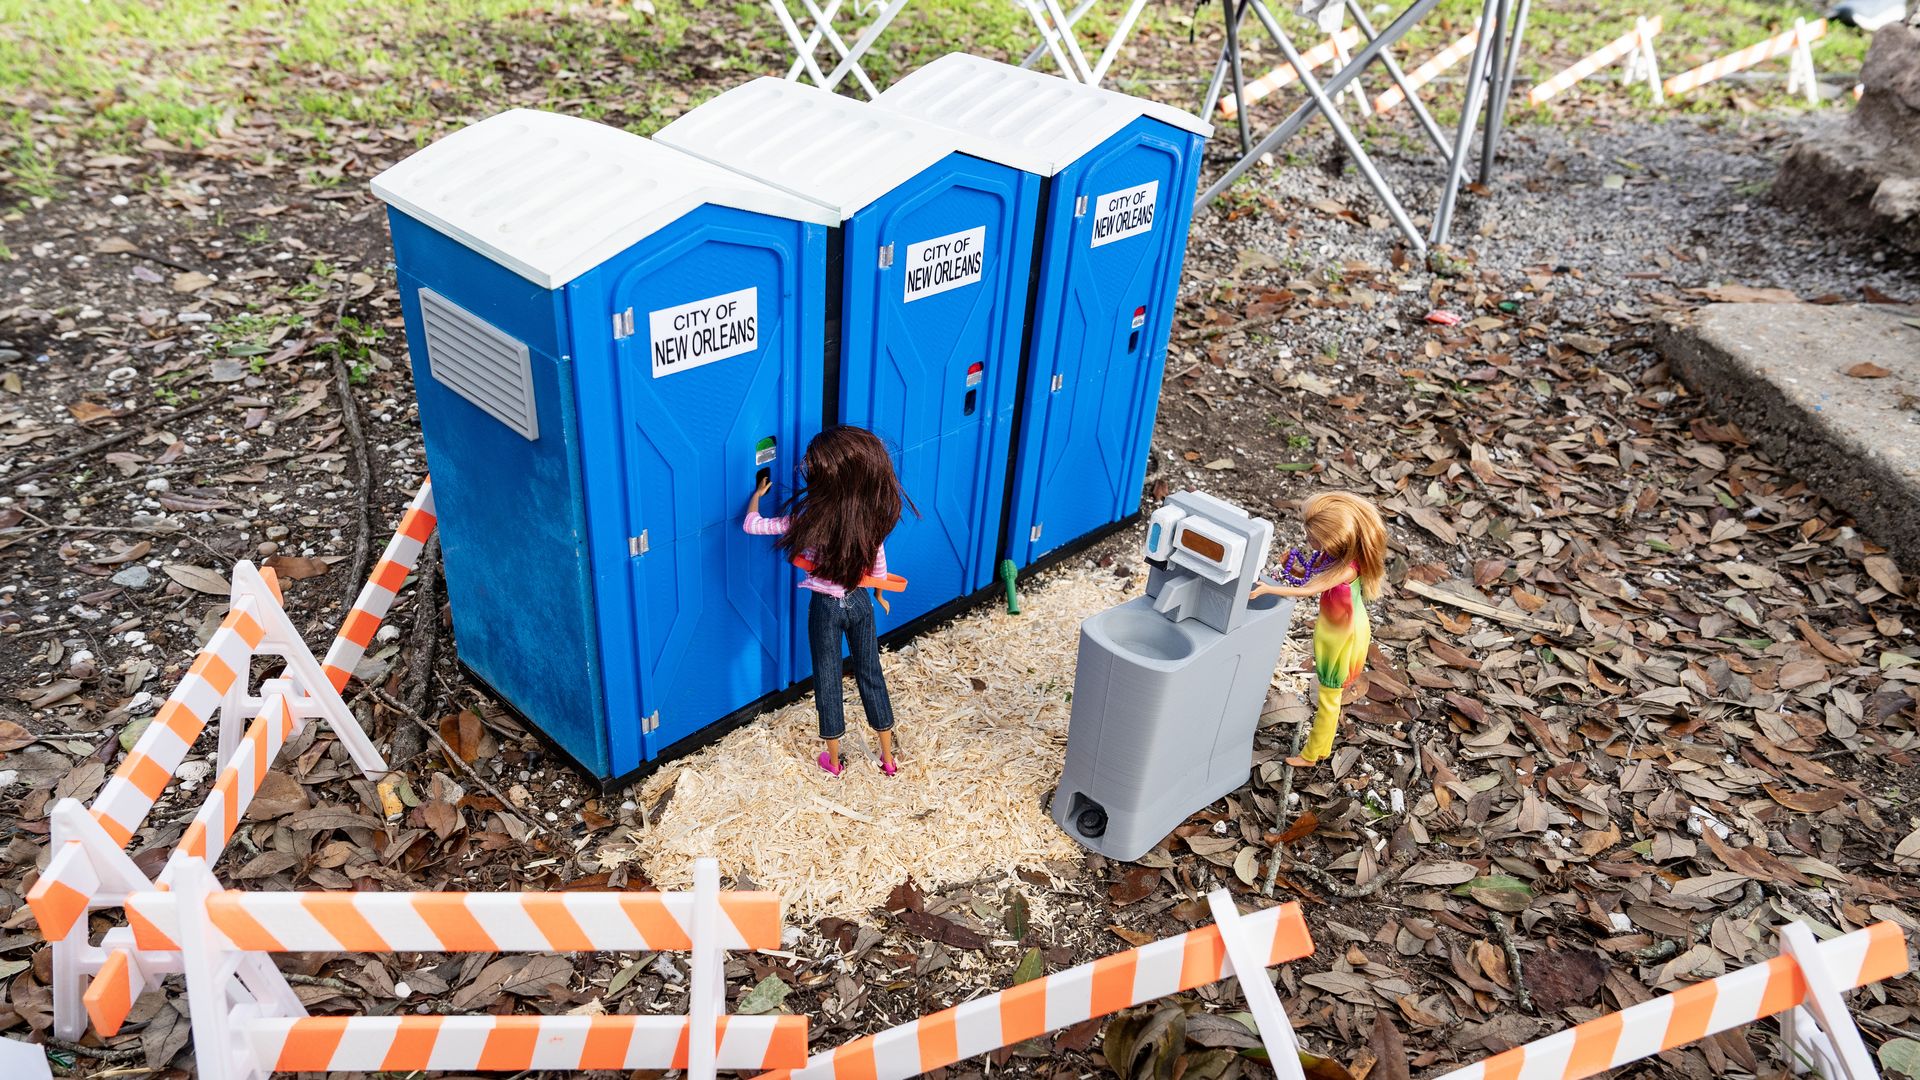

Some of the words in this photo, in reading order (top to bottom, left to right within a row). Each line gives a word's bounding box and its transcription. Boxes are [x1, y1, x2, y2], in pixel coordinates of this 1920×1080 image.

[1109, 195, 1131, 212] CITY
[1133, 190, 1147, 205] OF
[1094, 215, 1116, 240] NEW
[1116, 203, 1154, 233] ORLEANS
[923, 242, 951, 262] CITY
[954, 237, 971, 253] OF
[907, 265, 933, 293] NEW
[934, 251, 982, 285] ORLEANS
[673, 307, 711, 331] CITY
[716, 301, 737, 320] OF
[655, 334, 688, 367] NEW
[692, 316, 755, 357] ORLEANS
